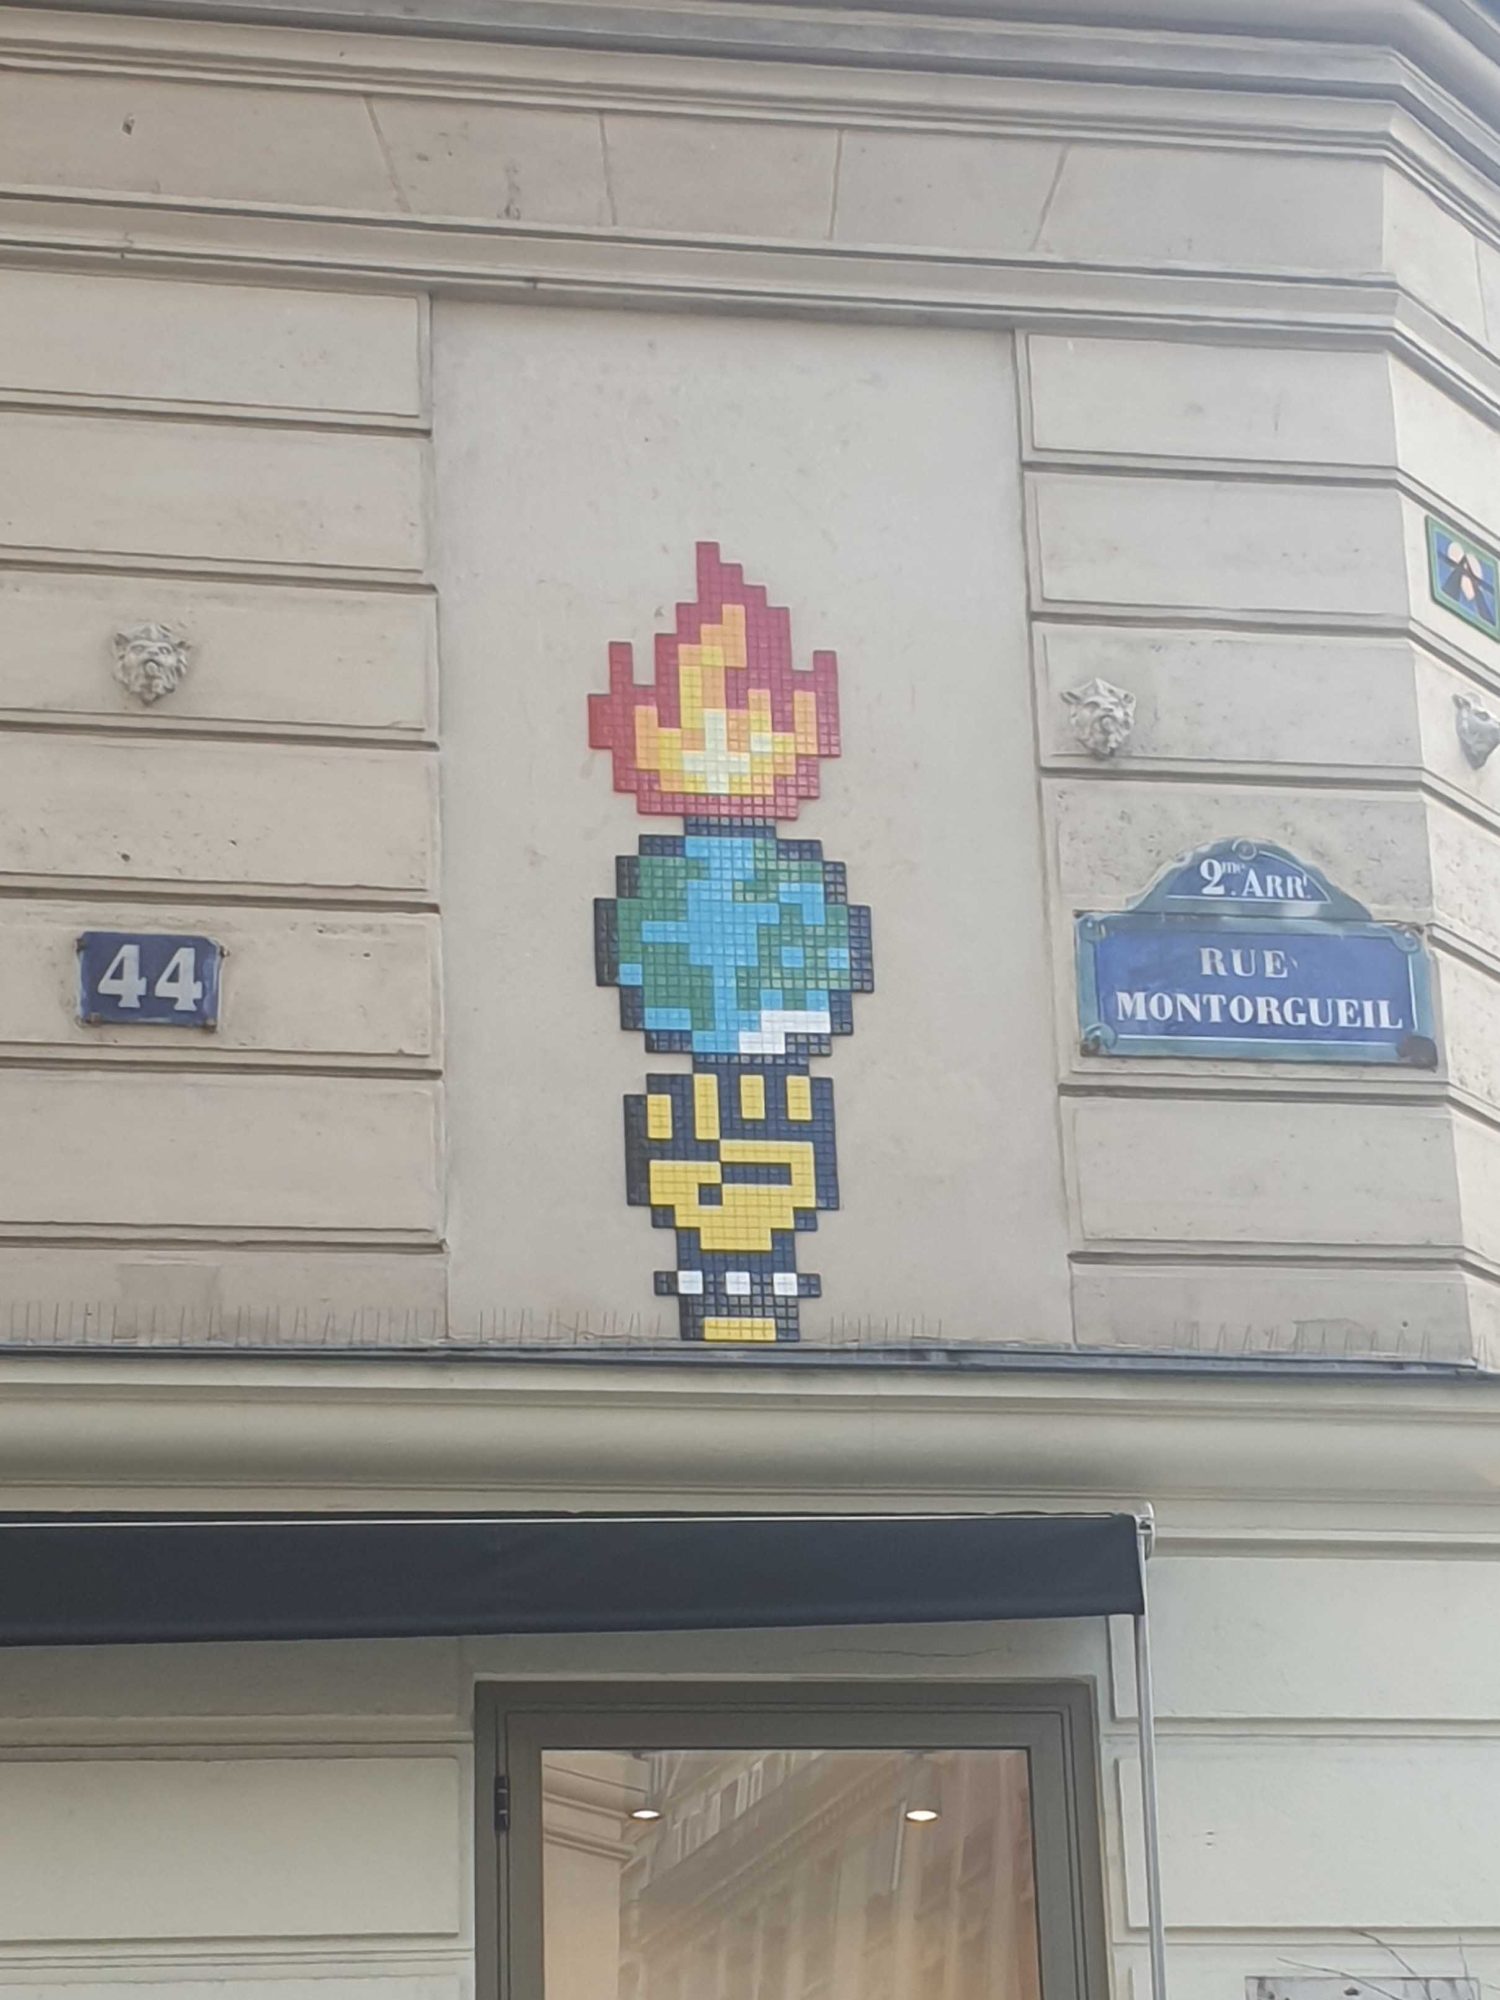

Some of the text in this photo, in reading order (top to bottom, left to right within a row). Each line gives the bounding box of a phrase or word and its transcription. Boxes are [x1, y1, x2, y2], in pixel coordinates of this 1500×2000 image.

[97, 944, 203, 1012] 44
[1200, 947, 1288, 979] RUE
[1115, 990, 1403, 1029] MONTORGUEIL
